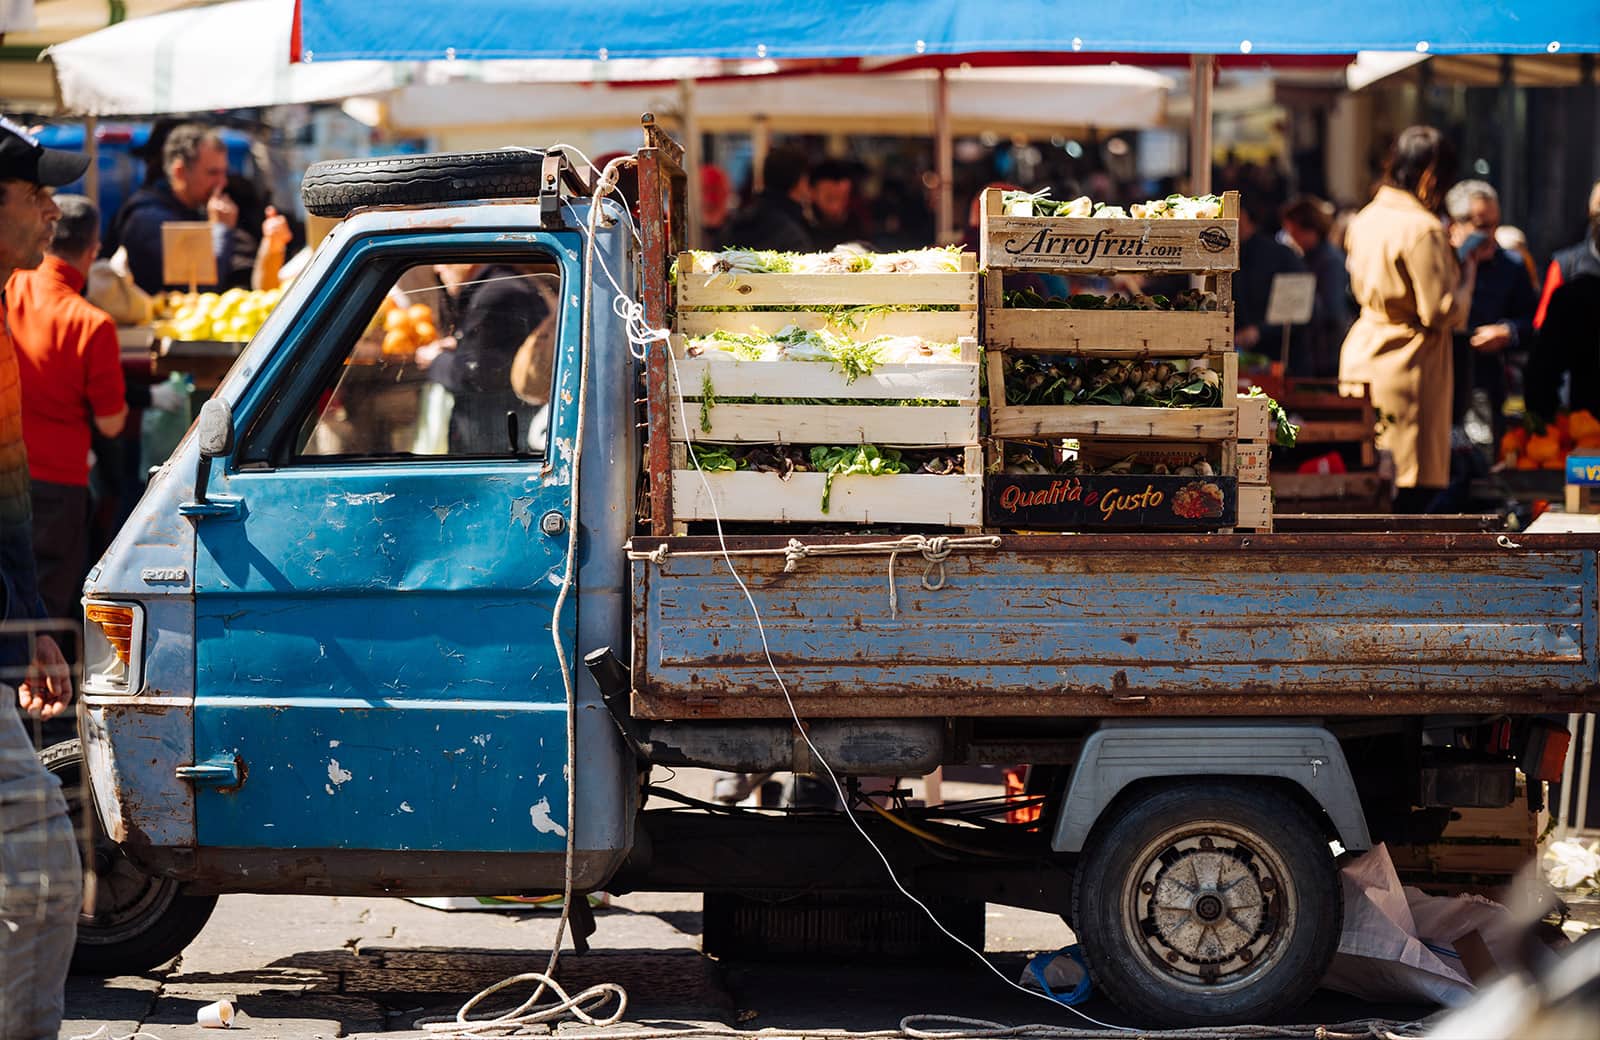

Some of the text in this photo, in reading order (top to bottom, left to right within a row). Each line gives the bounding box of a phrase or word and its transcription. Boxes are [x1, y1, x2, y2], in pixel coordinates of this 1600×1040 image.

[1004, 227, 1183, 265] Arrofrut.com
[1001, 477, 1165, 521] Qualità e Gusto
